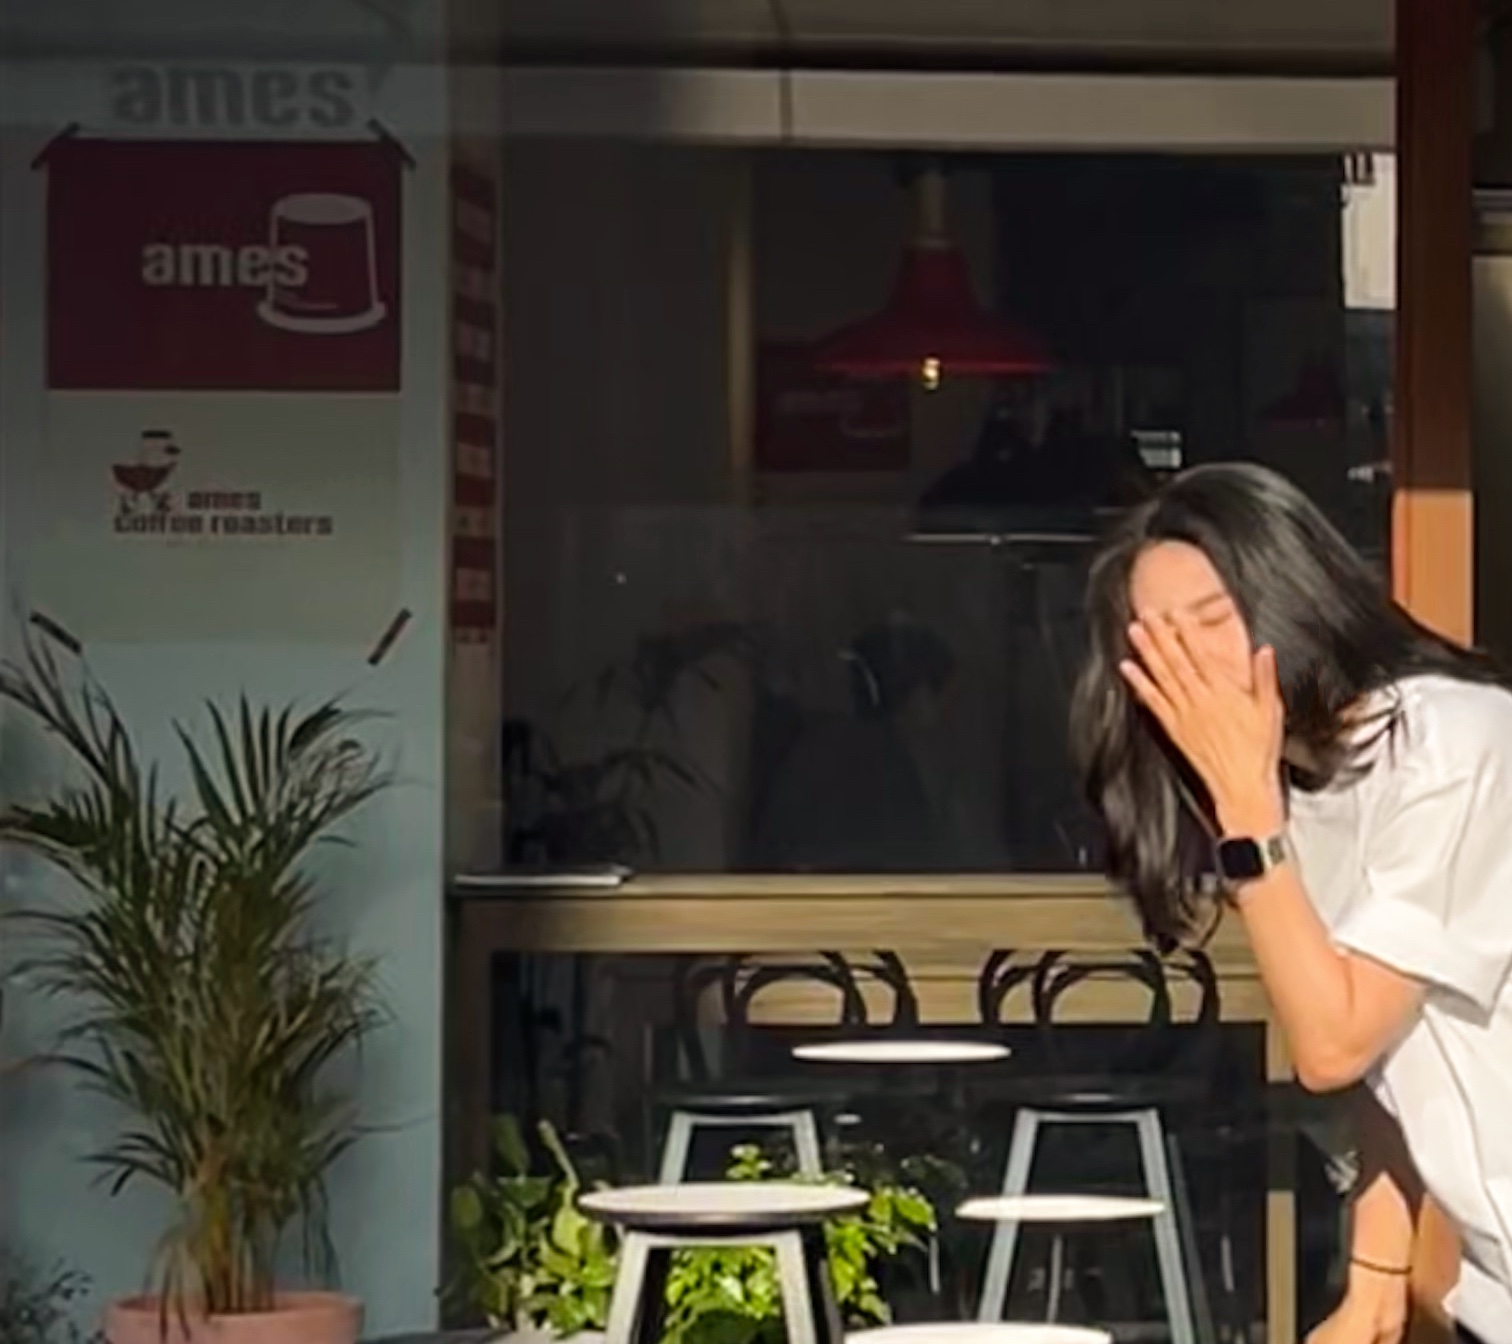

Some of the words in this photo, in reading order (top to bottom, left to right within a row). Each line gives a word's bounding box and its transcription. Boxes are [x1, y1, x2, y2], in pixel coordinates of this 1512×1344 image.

[114, 65, 353, 127] ames
[141, 243, 309, 287] ames
[188, 491, 261, 510] ames
[211, 511, 333, 535] roasters
